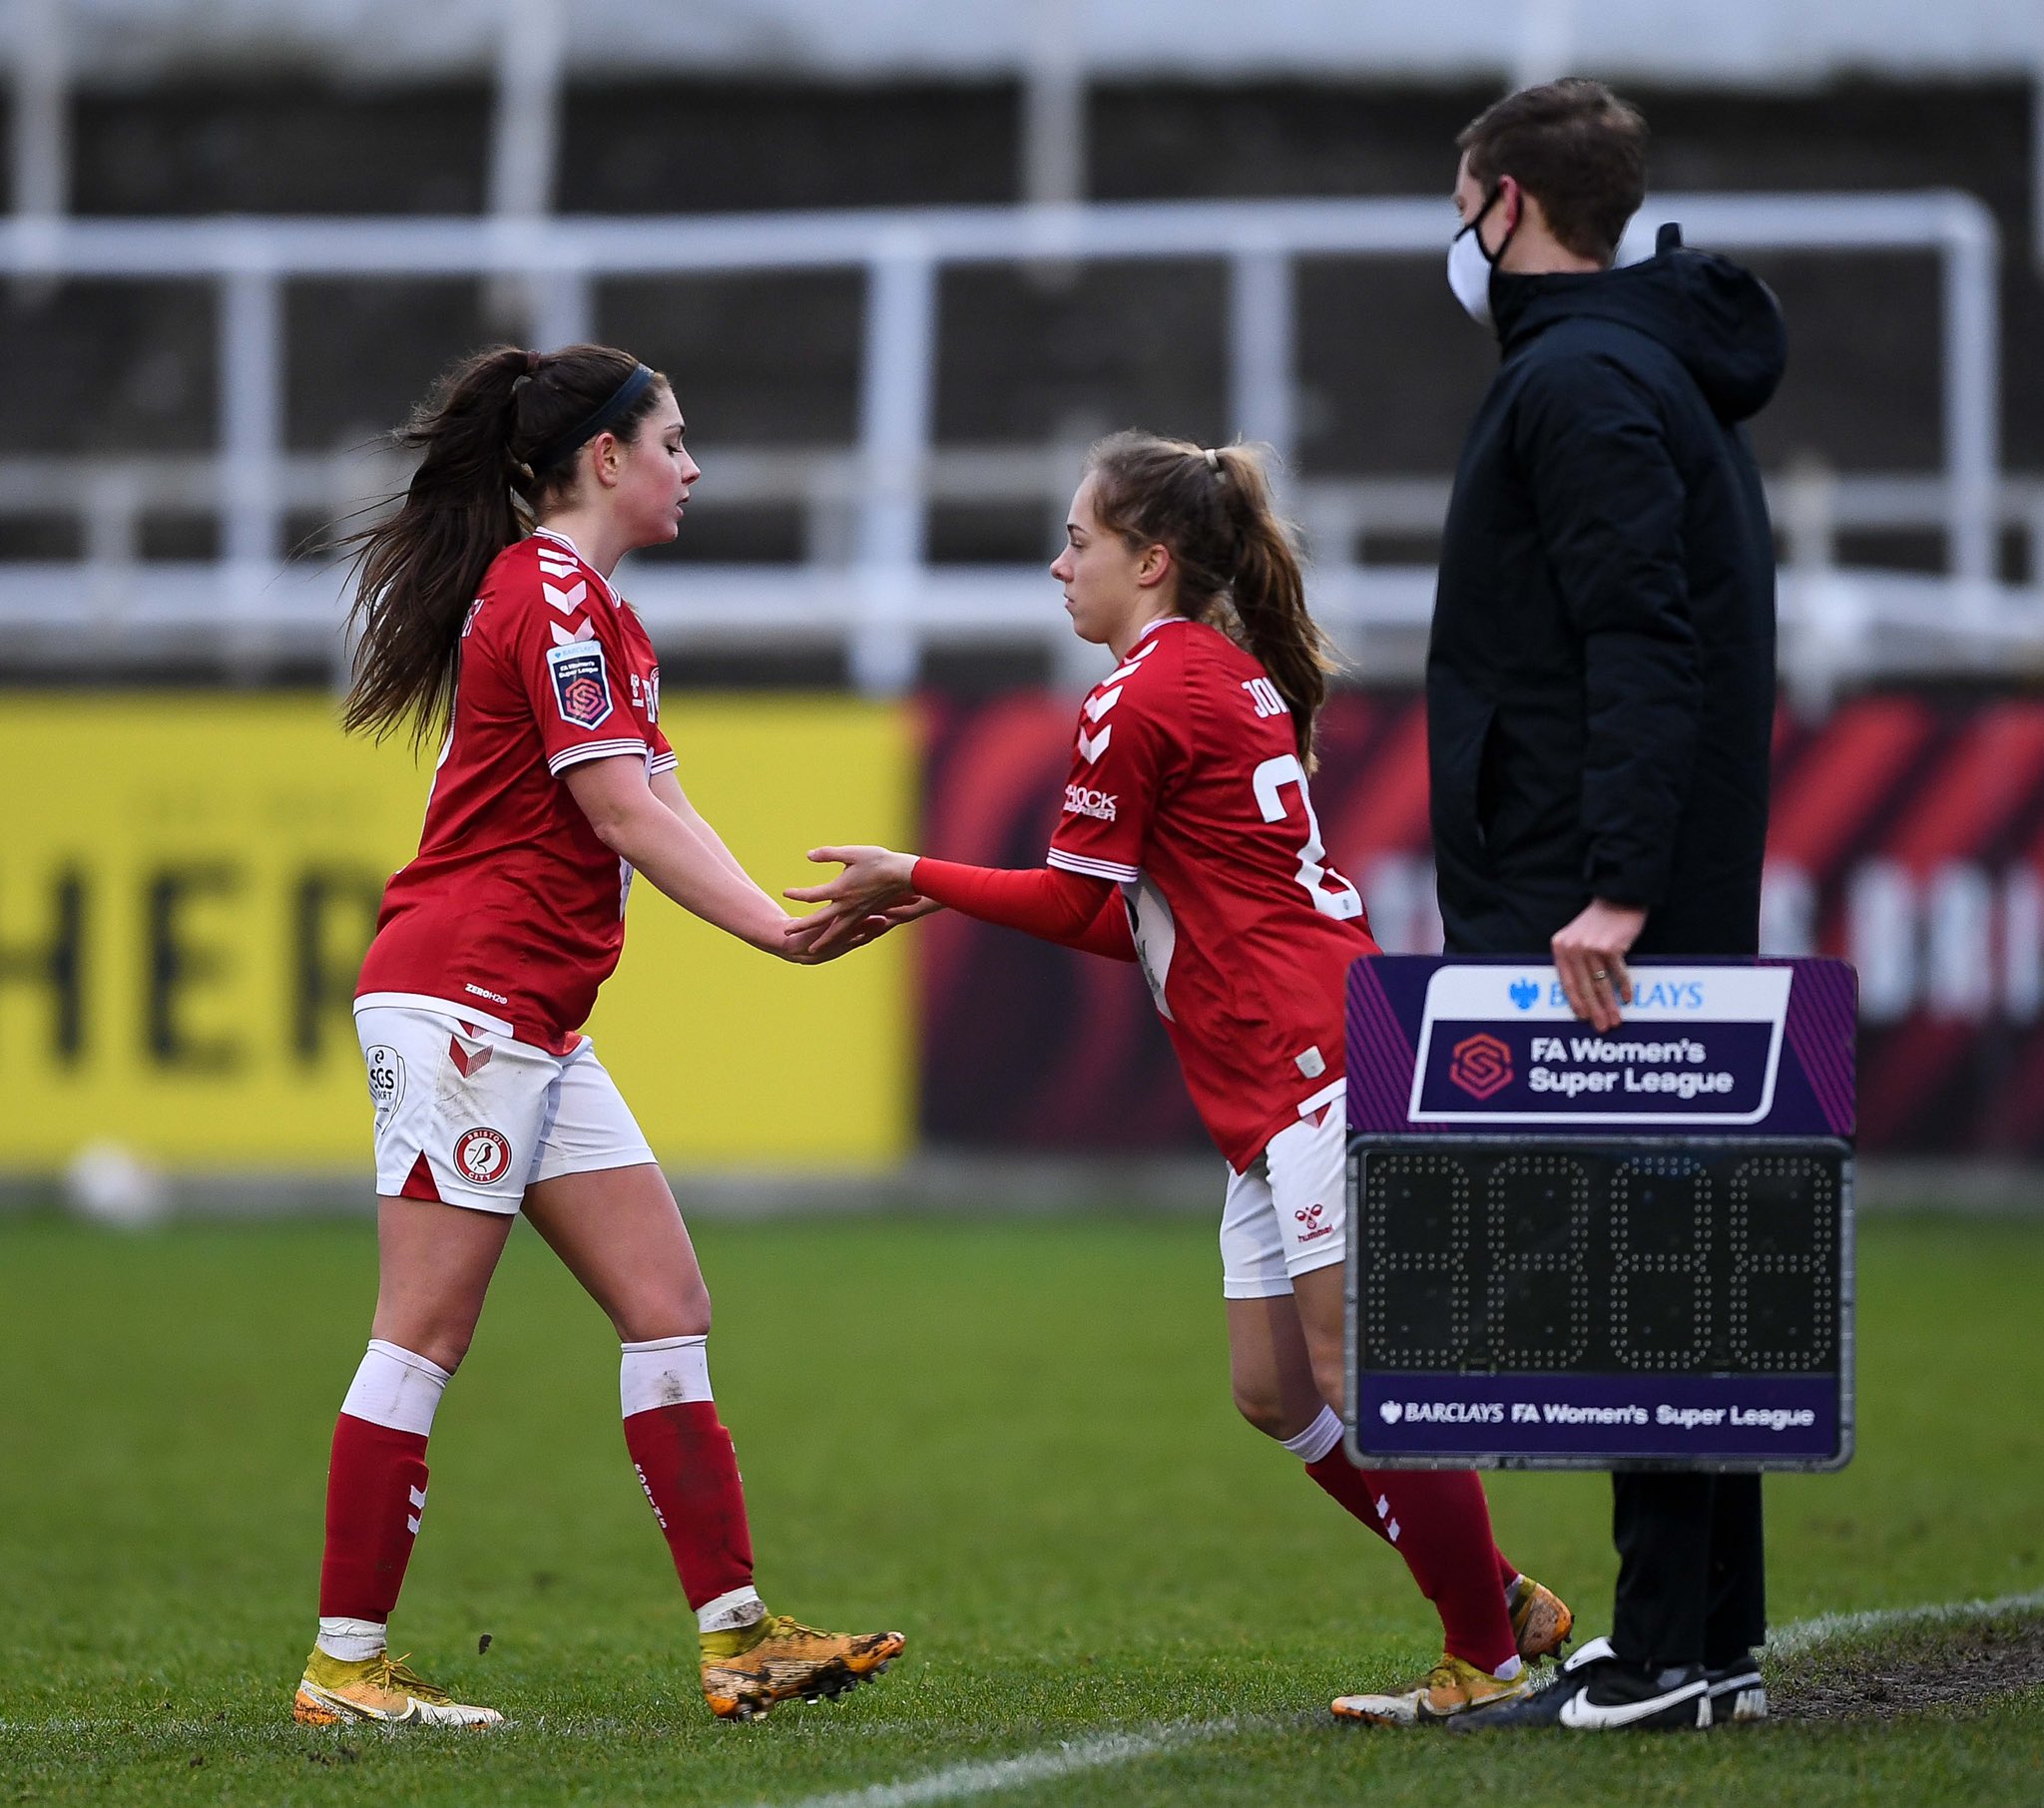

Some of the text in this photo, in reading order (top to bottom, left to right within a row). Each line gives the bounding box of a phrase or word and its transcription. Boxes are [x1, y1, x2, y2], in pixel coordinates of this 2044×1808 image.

[1550, 981, 1705, 1009] BLAYS
[1530, 1037, 1708, 1064] FA Women's
[1528, 1066, 1736, 1100] Super League
[467, 1130, 504, 1146] BRISTOL
[468, 1171, 492, 1181] CITY
[1404, 1402, 1815, 1431] BARCLAYS FA Women's Super League
